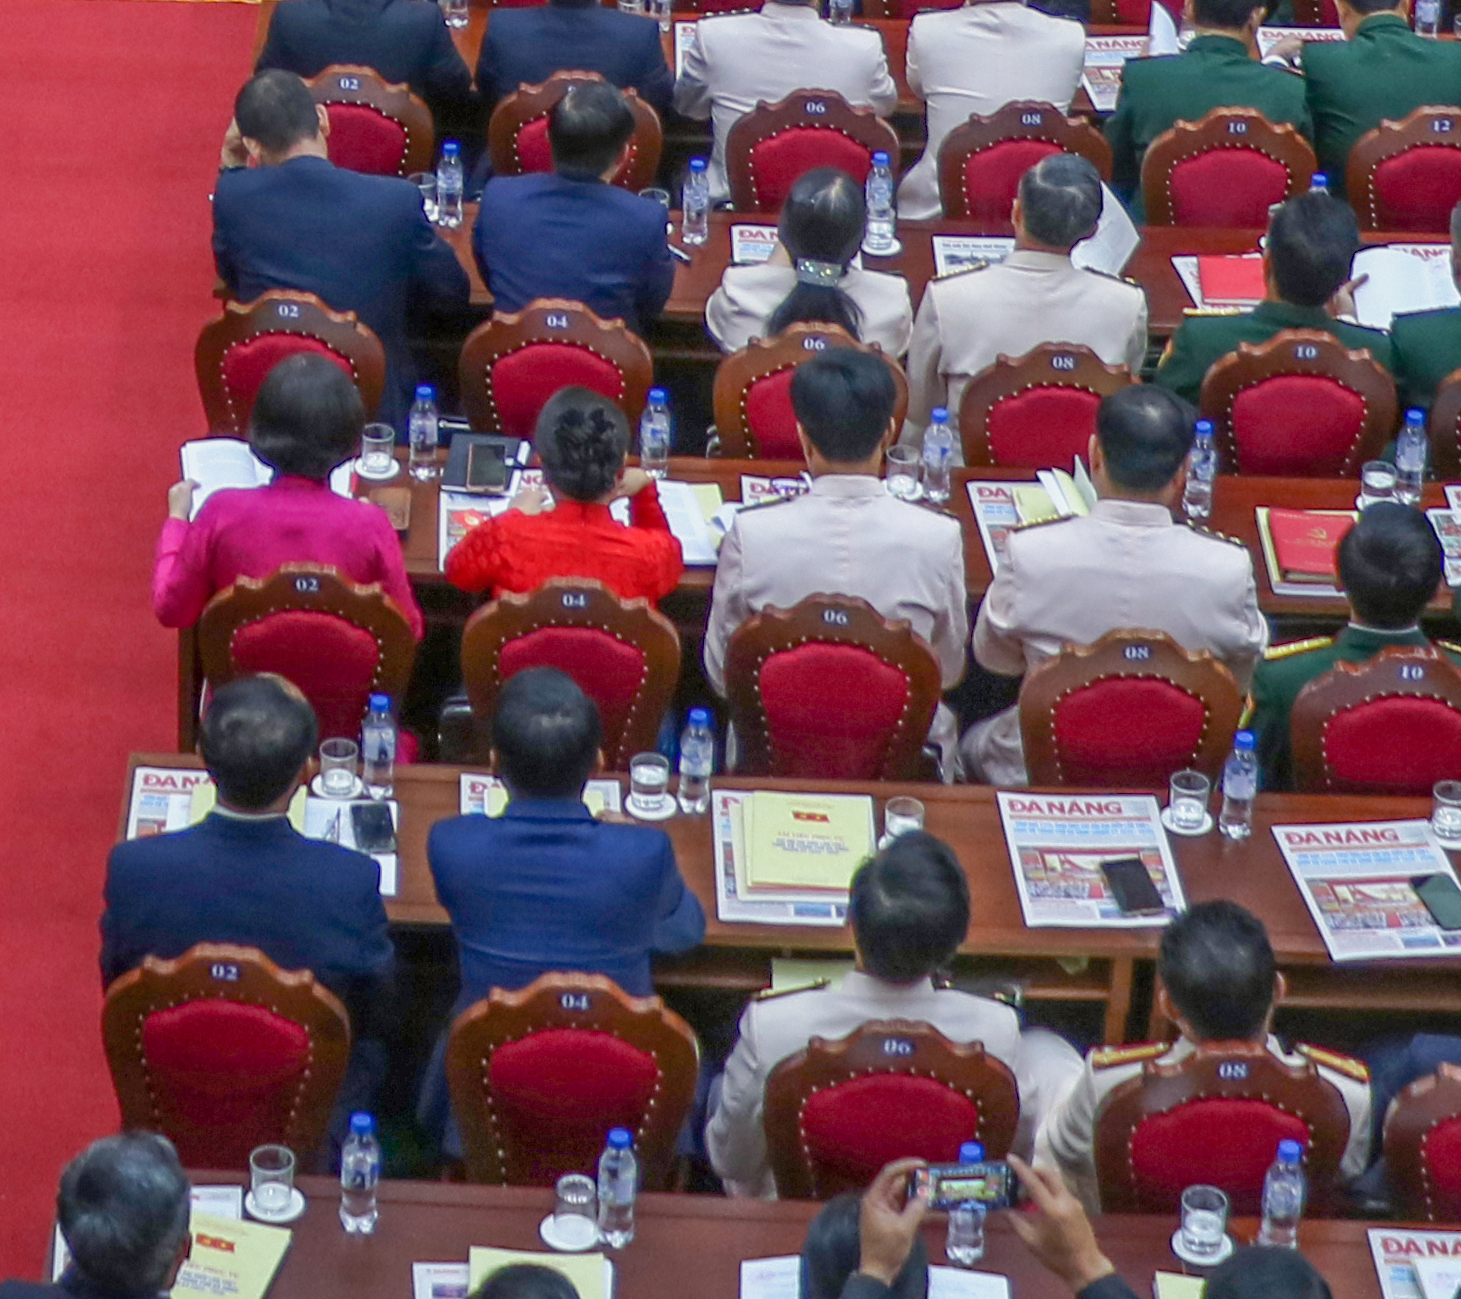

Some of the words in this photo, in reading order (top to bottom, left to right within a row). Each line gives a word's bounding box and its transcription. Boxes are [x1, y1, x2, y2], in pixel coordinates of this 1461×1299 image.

[278, 305, 299, 317] 02
[547, 315, 568, 328] 04
[296, 578, 317, 591] 02
[824, 610, 847, 624] 06
